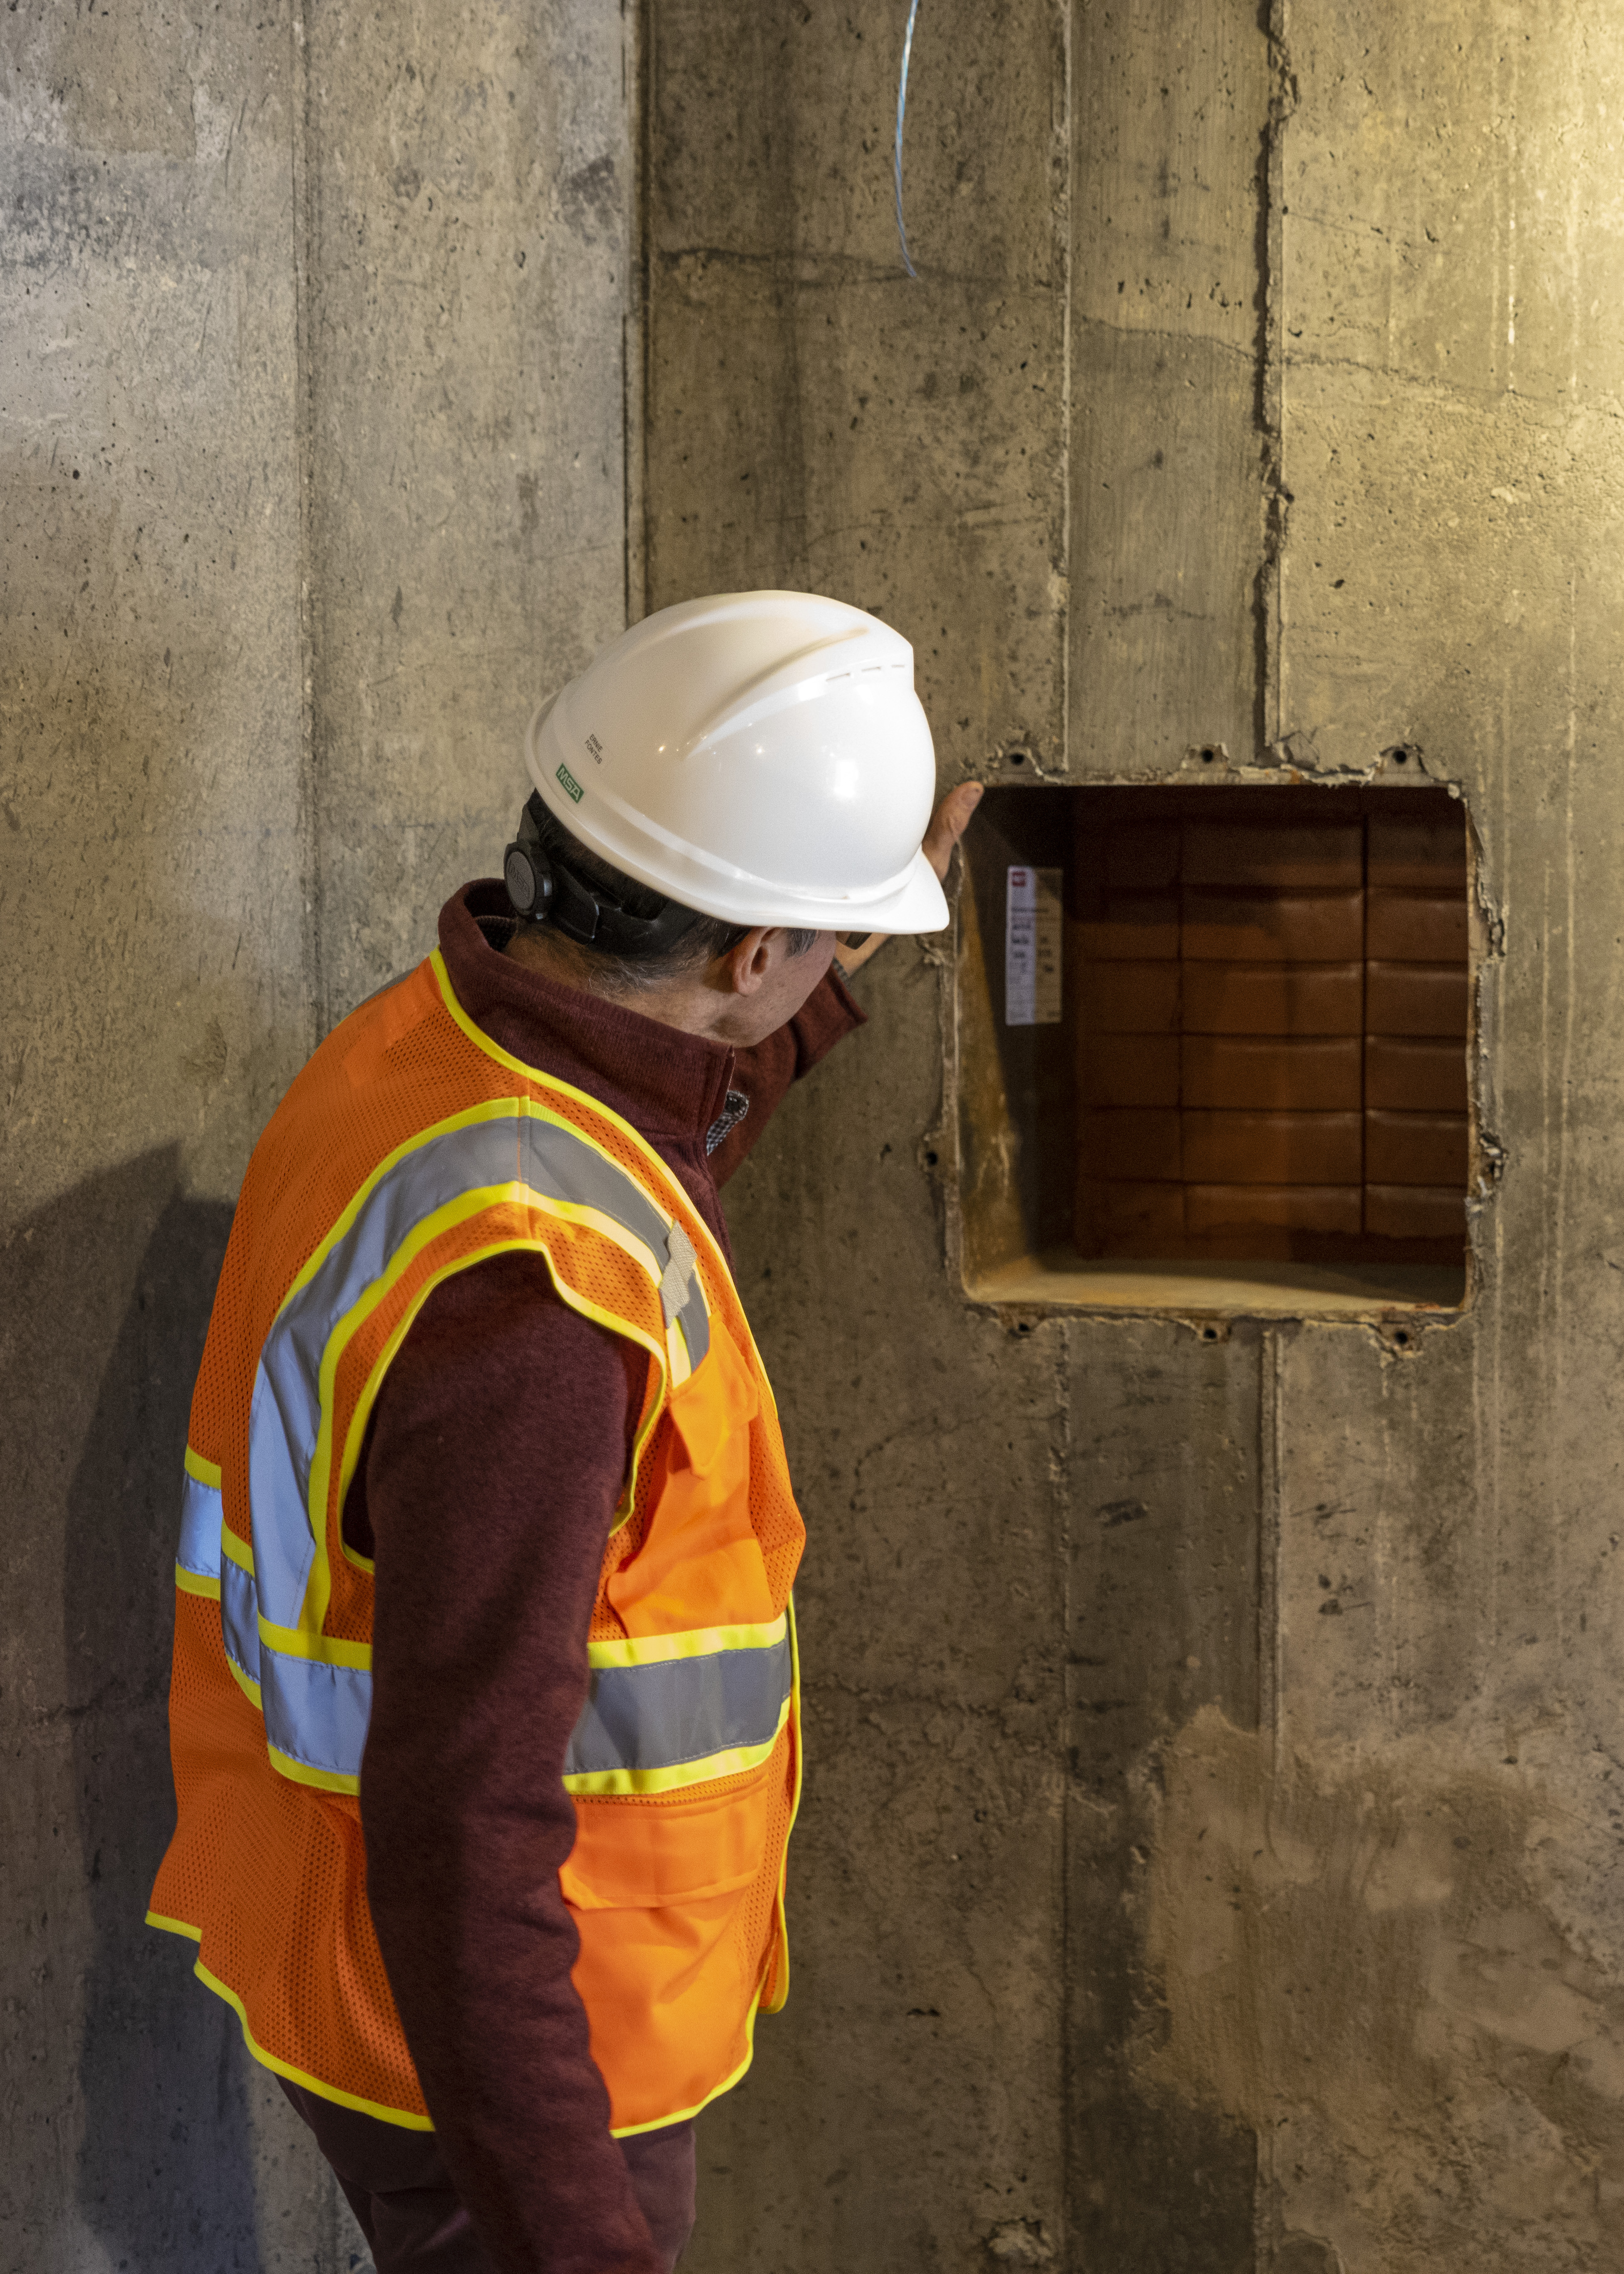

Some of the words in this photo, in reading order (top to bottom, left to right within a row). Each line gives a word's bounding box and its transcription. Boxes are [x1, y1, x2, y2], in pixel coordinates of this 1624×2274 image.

[585, 740, 602, 764] FONTES
[590, 734, 603, 752] ERNIE
[558, 767, 580, 801] MSA
